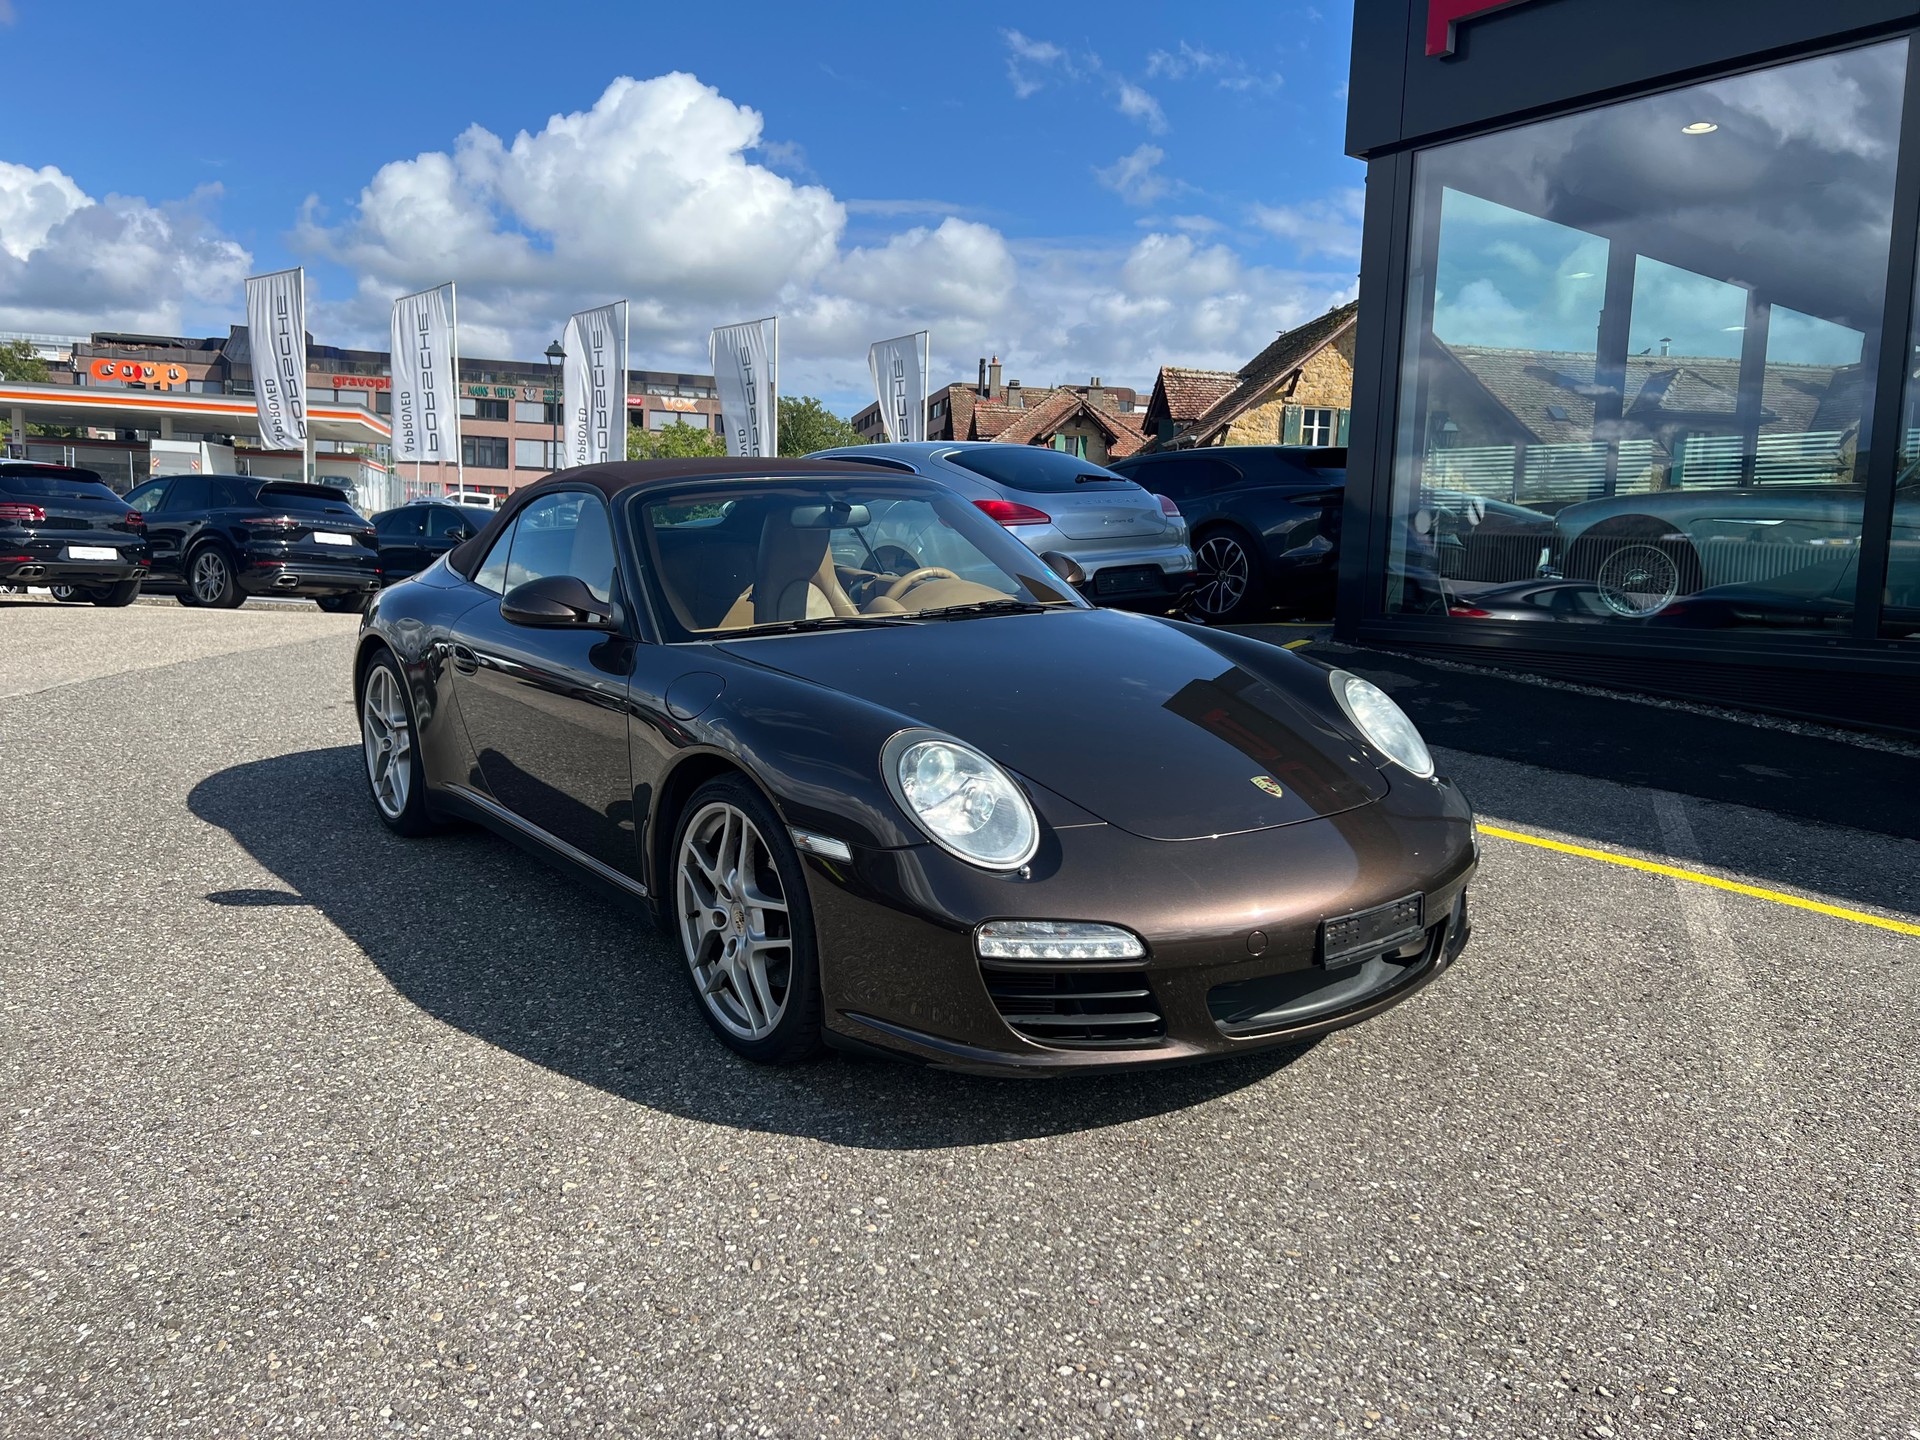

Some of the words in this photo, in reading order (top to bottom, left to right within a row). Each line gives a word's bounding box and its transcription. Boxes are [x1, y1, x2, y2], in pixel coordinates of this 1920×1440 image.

[91, 359, 188, 391] coop
[333, 376, 391, 391] gravopl
[660, 396, 699, 413] VOX
